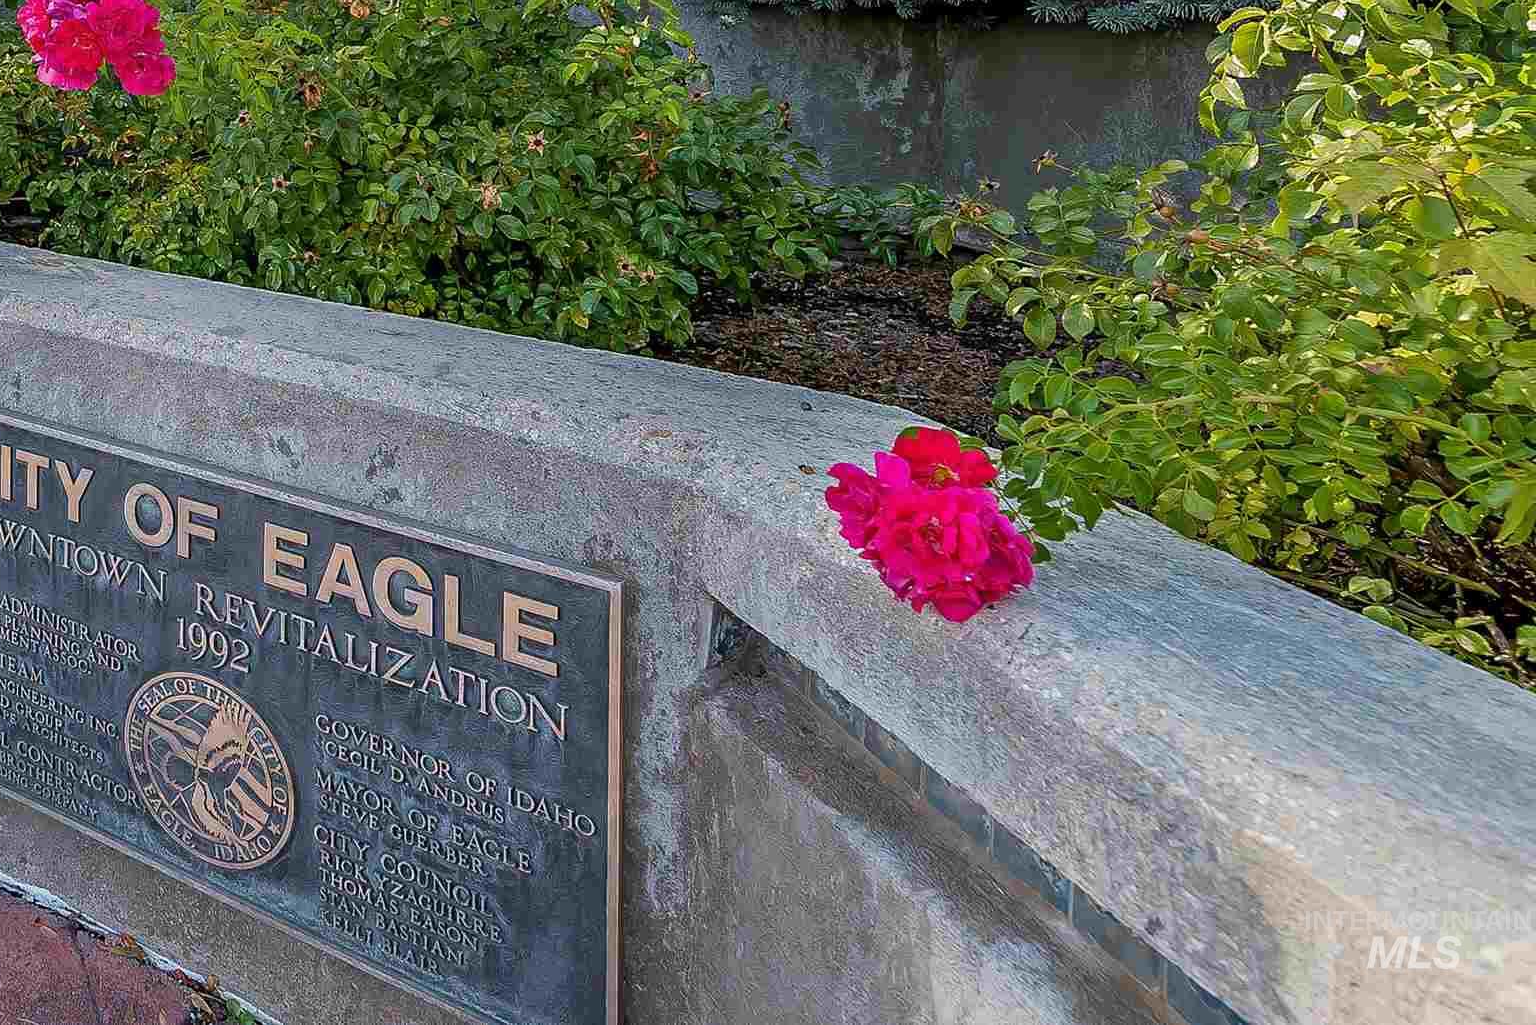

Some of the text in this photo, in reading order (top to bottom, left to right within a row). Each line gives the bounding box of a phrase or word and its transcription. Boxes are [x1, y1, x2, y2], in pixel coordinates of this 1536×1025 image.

[124, 482, 220, 559] OF
[264, 521, 560, 678] EAGLE
[0, 595, 141, 663] ADMINISTRATOR
[5, 614, 80, 655] PLANNING
[87, 648, 121, 671] AND
[175, 617, 250, 673] 1992
[193, 581, 568, 741] REVITALIZATION
[0, 653, 44, 685] TEAM
[15, 702, 63, 731] GROUP
[23, 724, 104, 763] ARCHITECTS
[89, 715, 119, 739] INC.
[128, 717, 146, 752] THE
[137, 681, 172, 715] SEAL
[174, 678, 196, 695] OF
[272, 786, 287, 815] OF
[0, 751, 73, 795] BROTHERS
[16, 740, 140, 808] CONTRACTOR
[315, 714, 596, 837] GOVERNOR OF IDAHO
[325, 740, 505, 824] CECIL D. ANDRUS
[214, 834, 272, 862] IDAHO
[315, 768, 532, 873] MAYOR OF EAGLE
[319, 793, 487, 877] STEVE GUERBER
[314, 824, 493, 918] CITY COUNCIL
[320, 849, 502, 944] RICK YZAGUIRRE
[319, 866, 479, 952] THOMAS EASON
[319, 887, 464, 967] STAN BASTIAN
[382, 937, 440, 975] BLAIR
